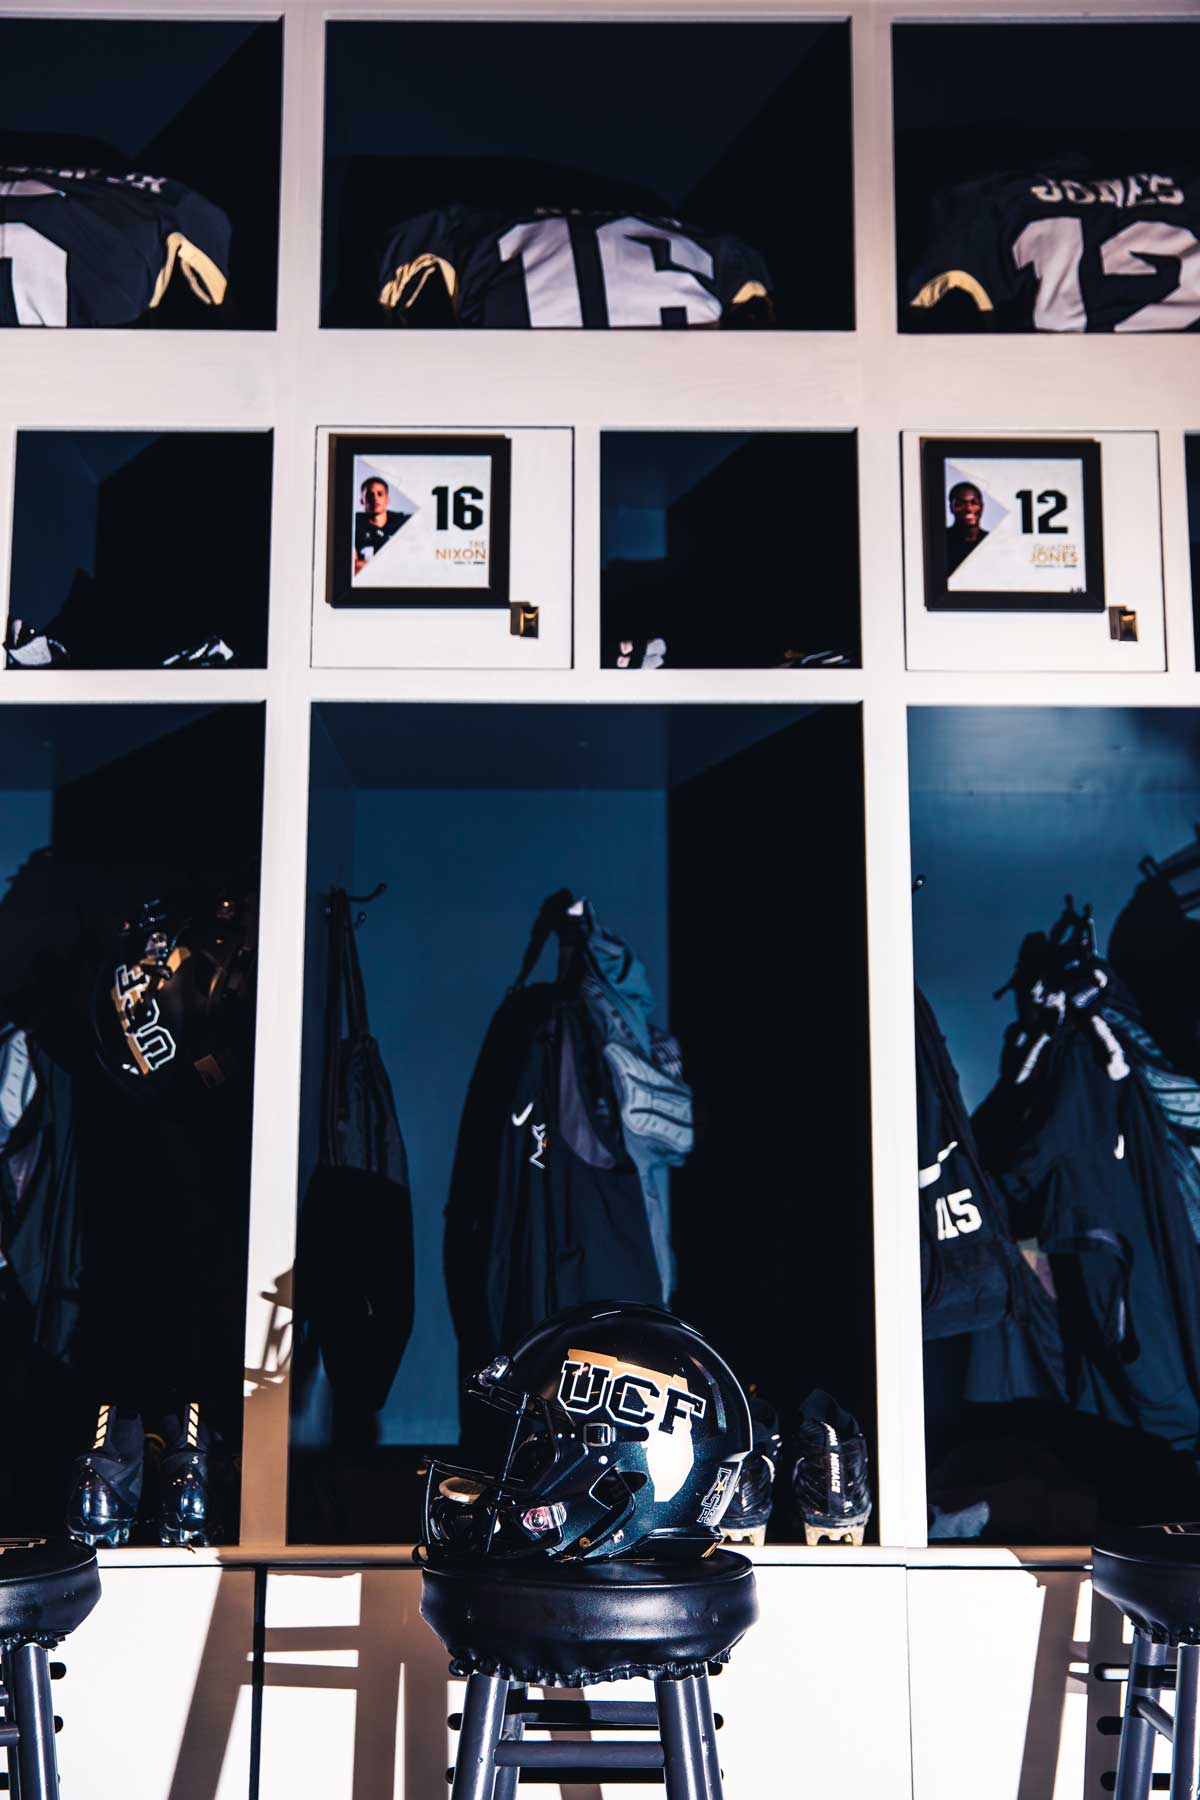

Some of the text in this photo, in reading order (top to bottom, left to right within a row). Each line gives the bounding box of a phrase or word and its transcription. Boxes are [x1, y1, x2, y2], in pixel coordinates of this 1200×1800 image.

[432, 486, 483, 530] 16
[1016, 490, 1067, 533] 12
[435, 549, 486, 559] NIXON
[557, 1360, 706, 1434] UCF
[830, 1452, 840, 1493] MENACE
